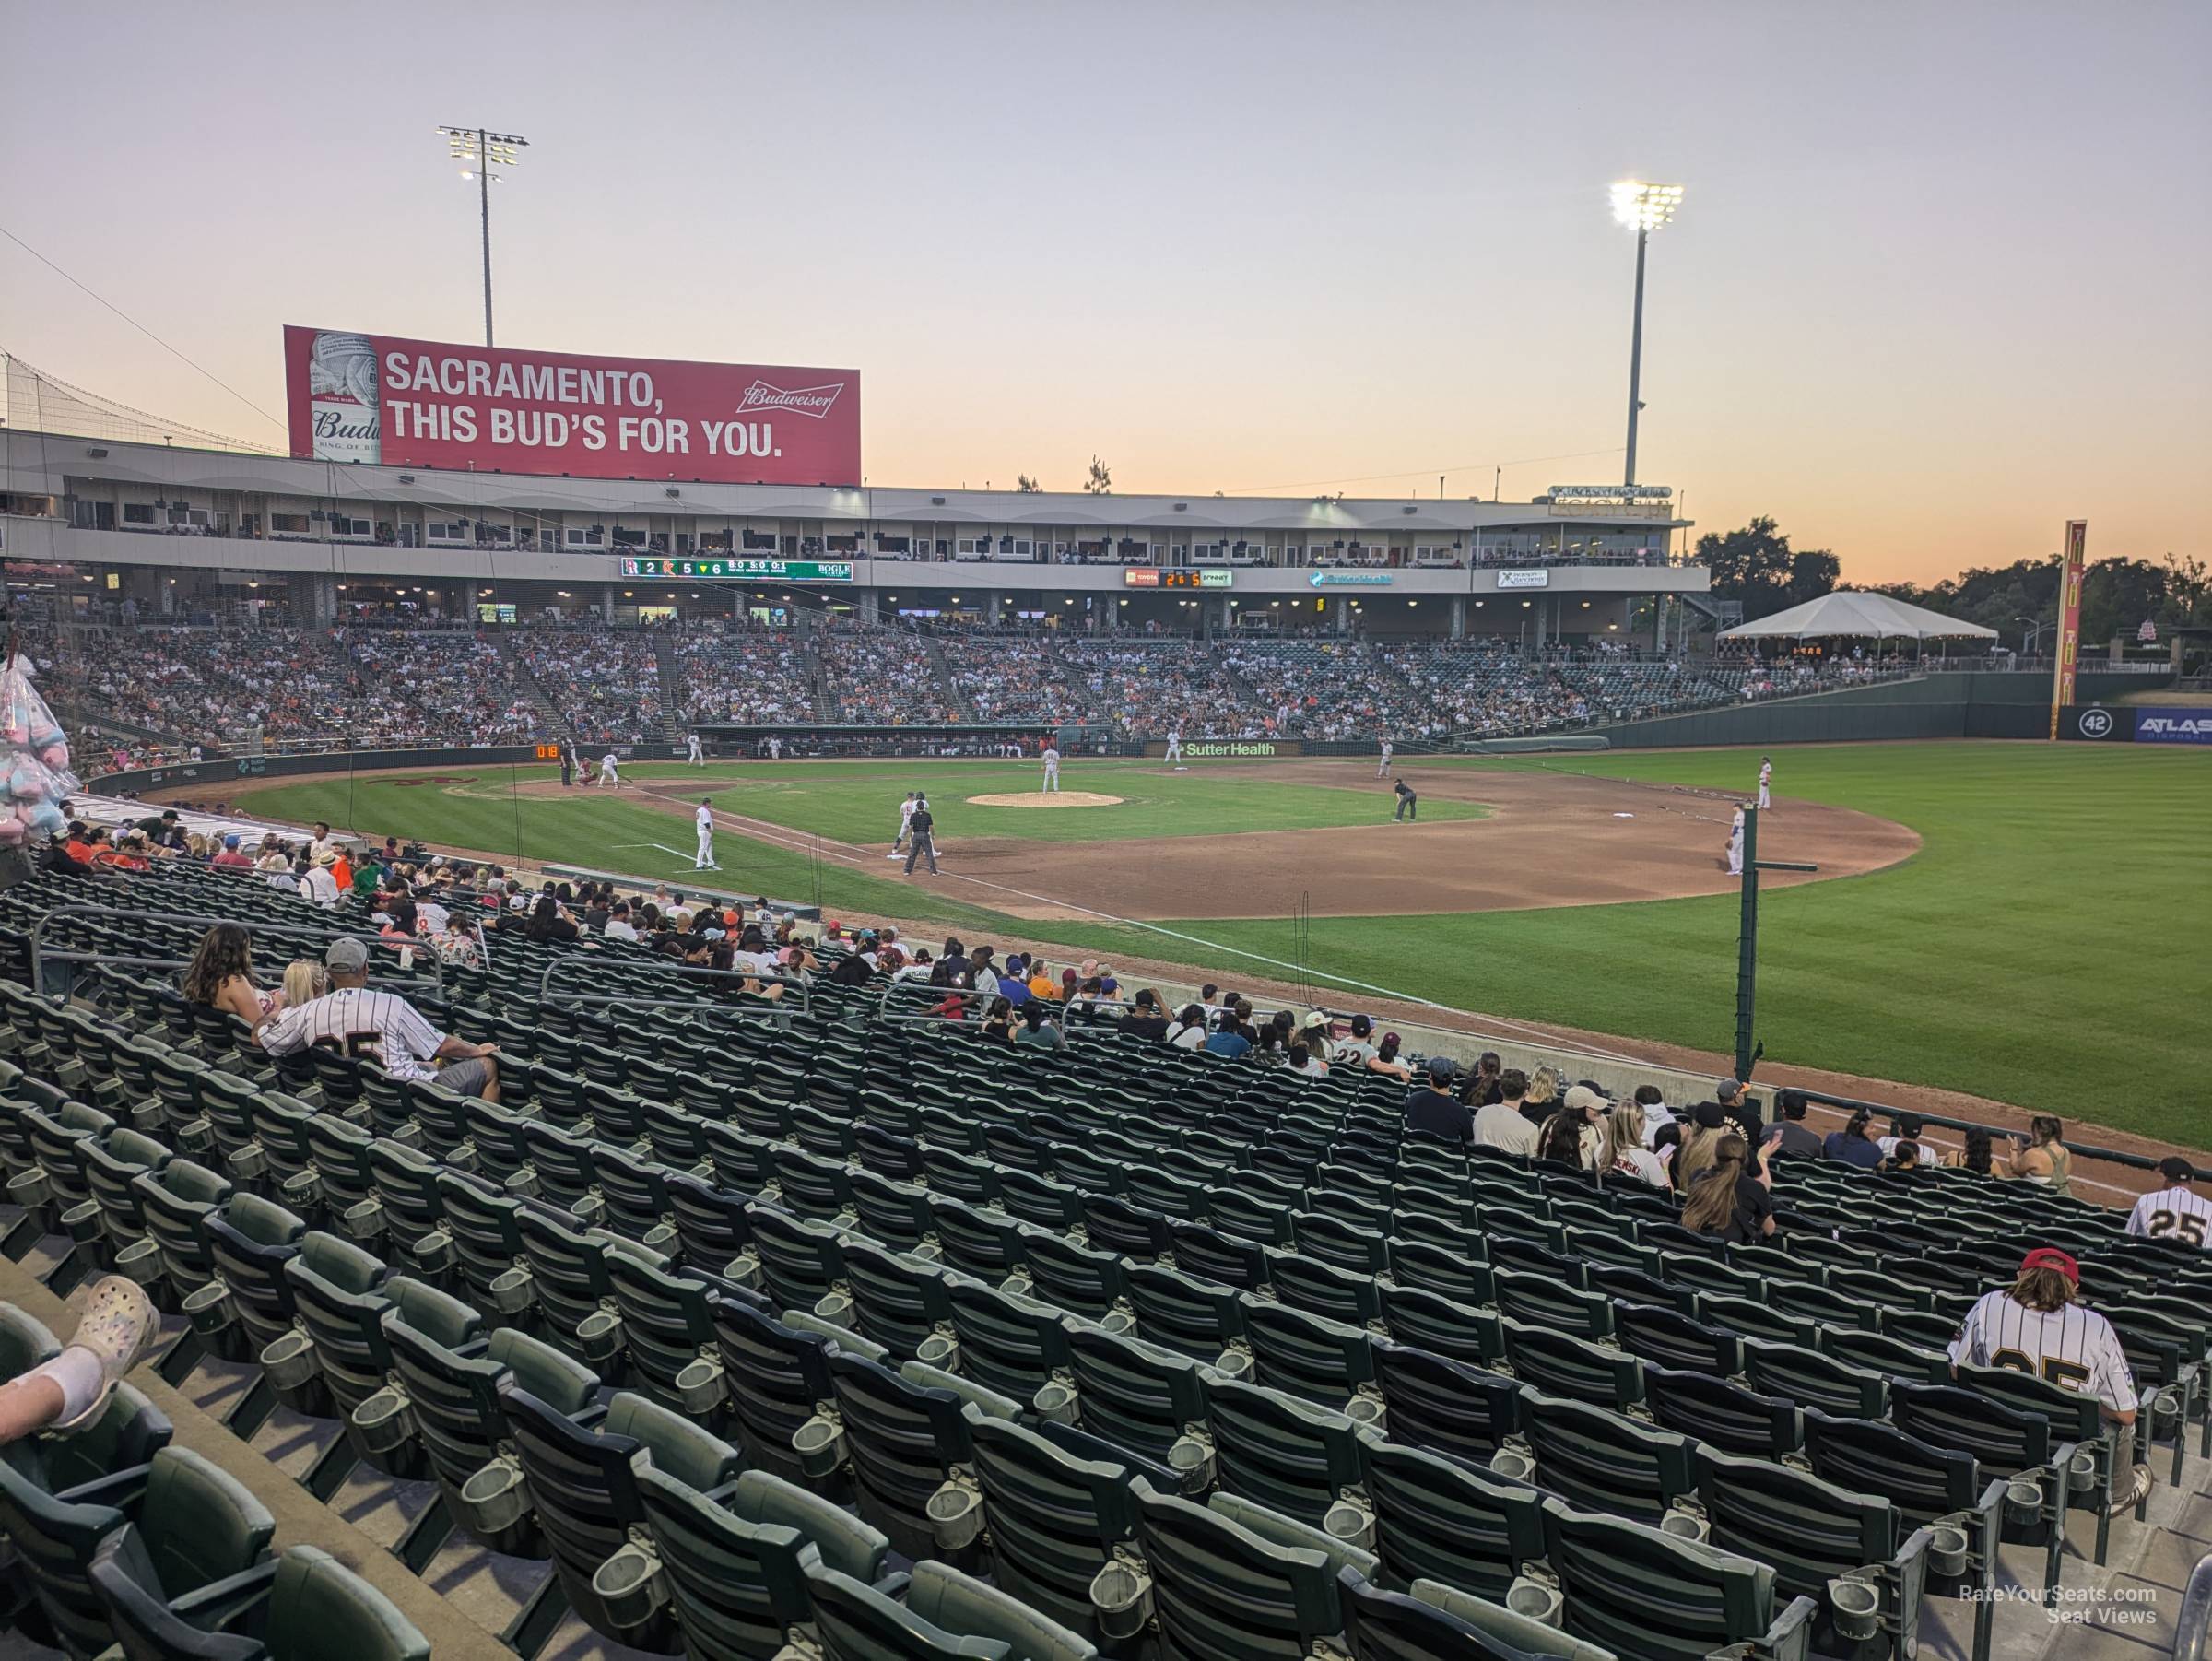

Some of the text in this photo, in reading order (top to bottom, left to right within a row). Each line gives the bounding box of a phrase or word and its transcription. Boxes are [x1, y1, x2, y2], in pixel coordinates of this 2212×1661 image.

[385, 352, 663, 415] SACRAMENTO,
[744, 387, 832, 407] Budweiser
[386, 399, 782, 457] THIS BUD'S FOR YOU.
[647, 562, 655, 573] 2
[684, 563, 692, 573] 5
[712, 564, 721, 574] 6
[818, 564, 851, 572] BOGLE
[1166, 574, 1175, 586] 2
[1192, 574, 1200, 586] 5
[2085, 716, 2105, 730] 42
[2139, 718, 2212, 734] ATLAS
[1186, 742, 1275, 756] Sutter Health
[1337, 1049, 1361, 1066] 22
[2147, 1210, 2206, 1245] 25
